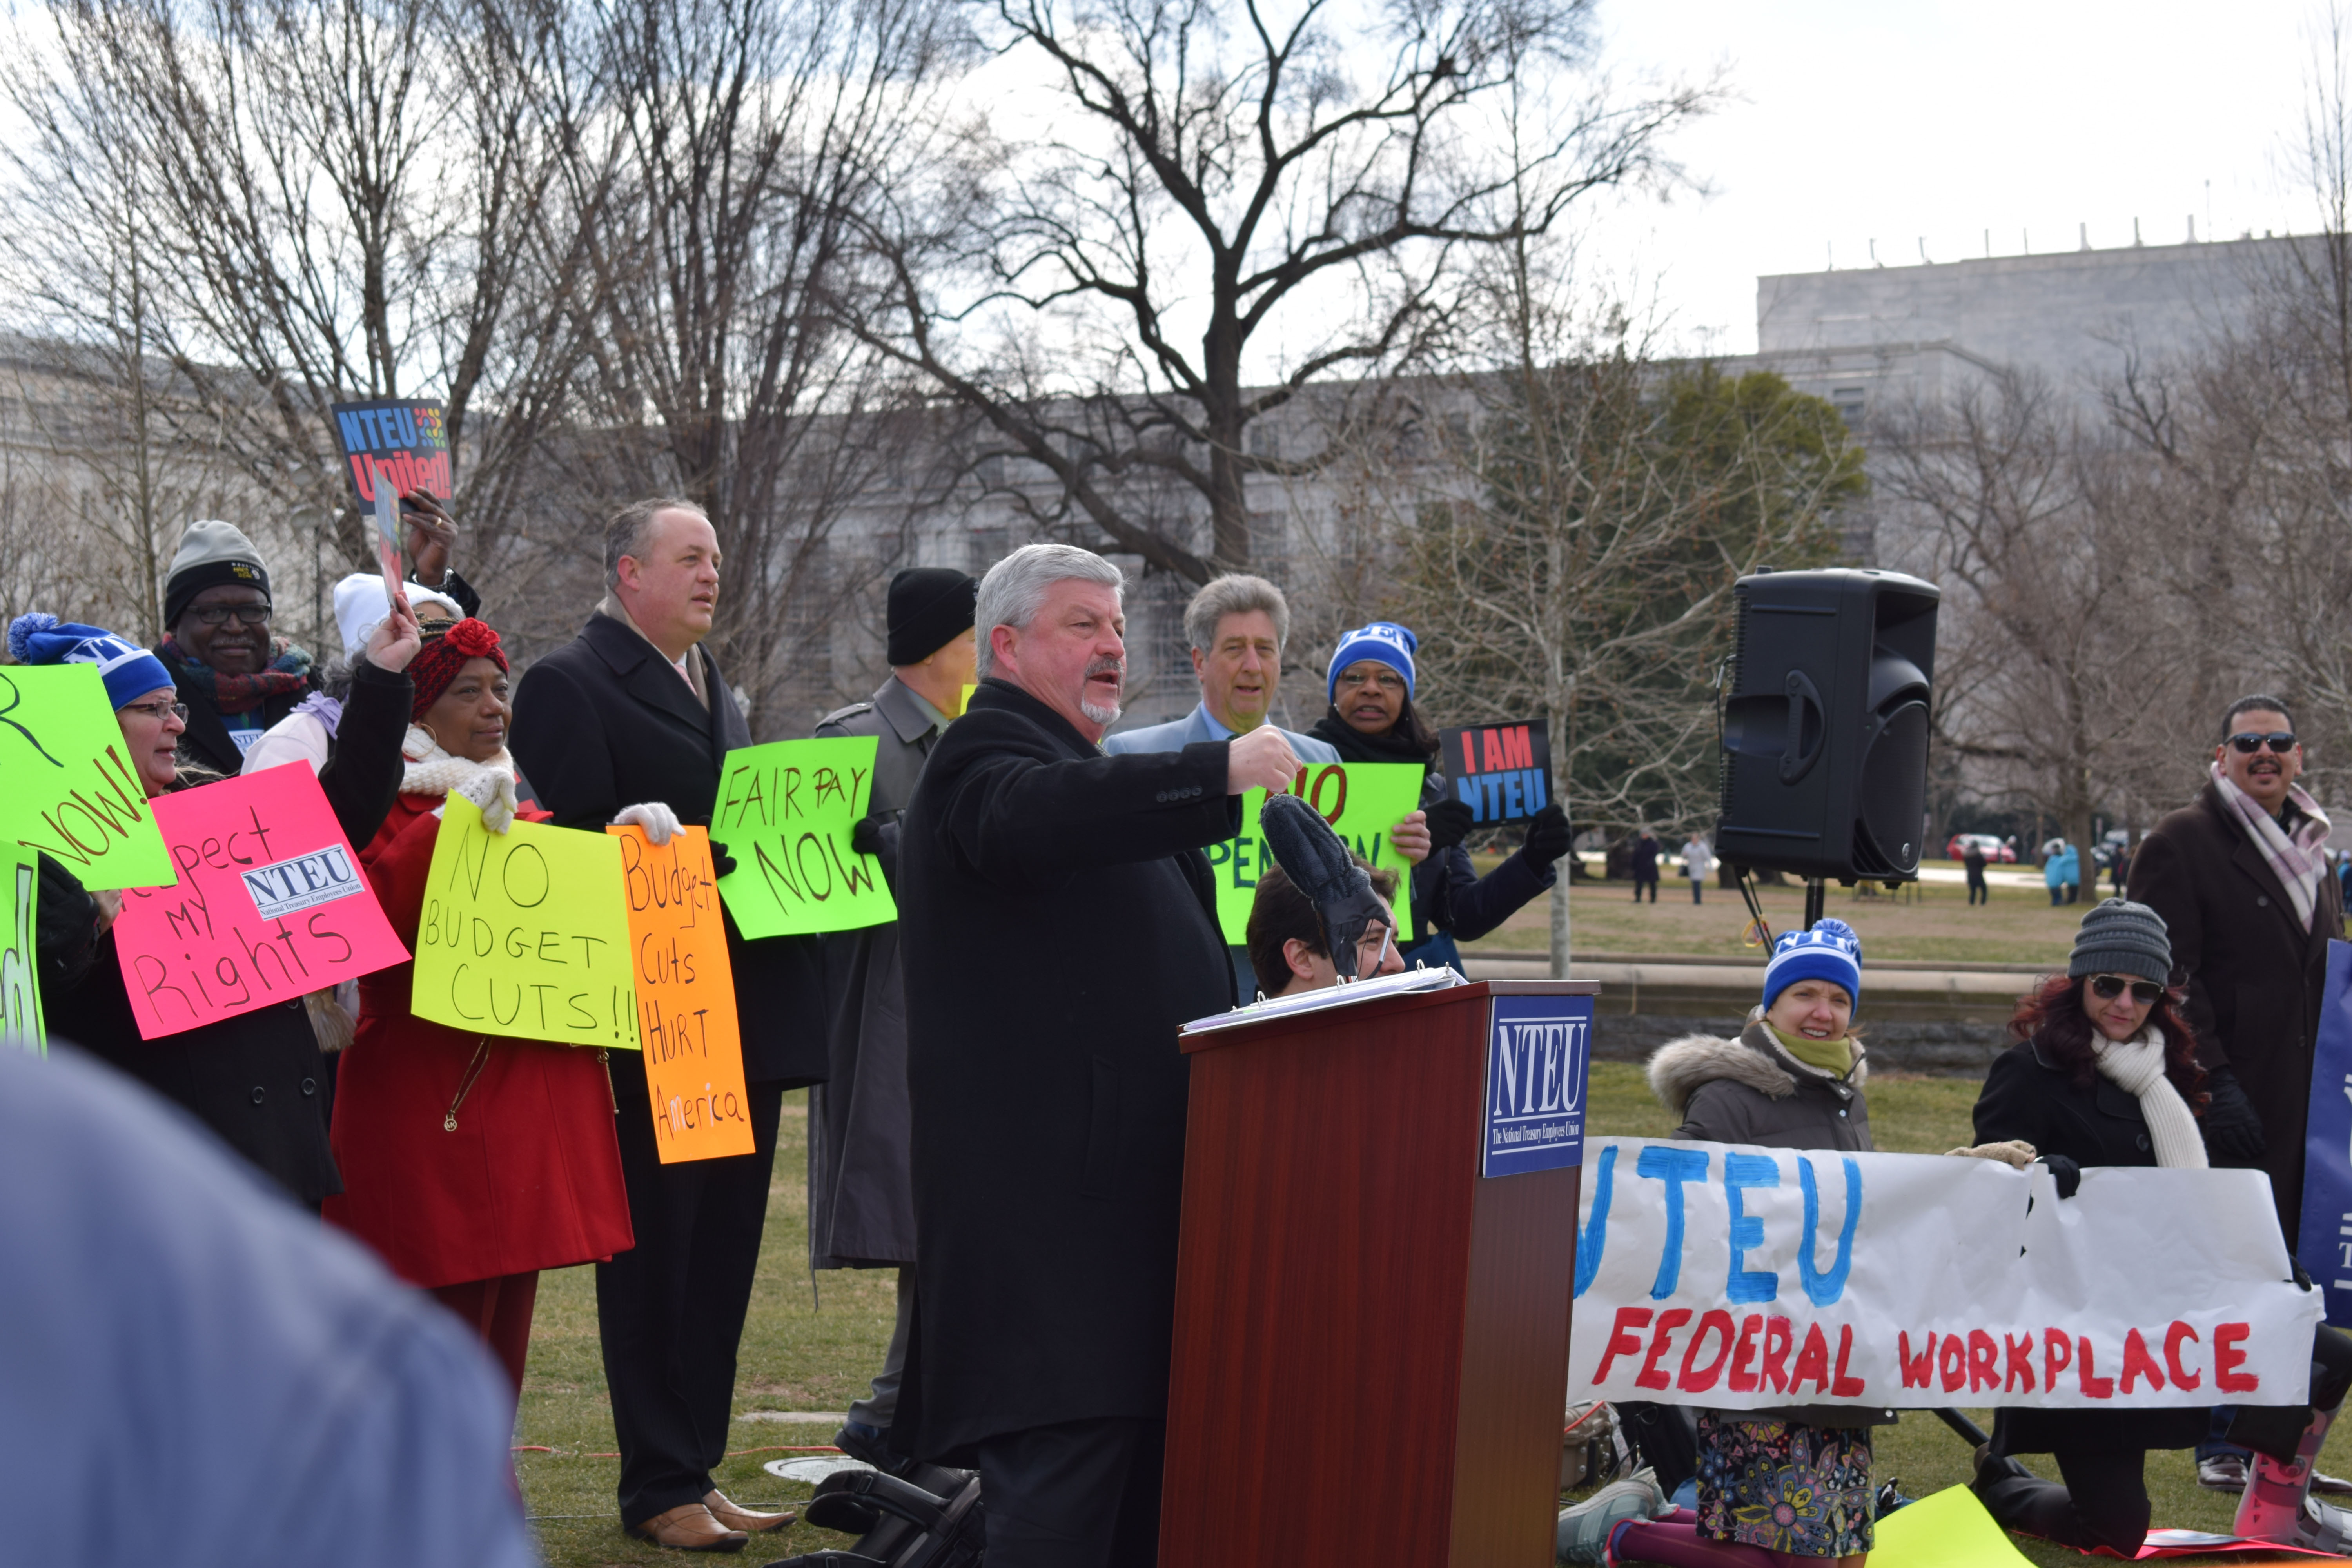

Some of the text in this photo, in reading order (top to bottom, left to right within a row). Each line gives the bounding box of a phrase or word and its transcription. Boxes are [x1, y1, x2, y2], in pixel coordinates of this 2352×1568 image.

[338, 407, 417, 452] NTEU
[350, 450, 452, 502] United!
[1461, 725, 1533, 774] I AM
[18, 744, 148, 866] NOW!
[720, 765, 867, 828] FAIR PAY
[1457, 768, 1547, 822] NTEU
[120, 805, 274, 912] pect
[243, 849, 351, 906] NTEU
[449, 823, 549, 908] NO
[620, 834, 712, 929] Budget
[753, 831, 875, 916] NOW
[165, 898, 215, 941] MY
[260, 883, 361, 916] National Treasury Employees Union
[425, 899, 608, 968] BUDGET
[640, 933, 695, 984] Cuts
[134, 912, 353, 1024] Rights
[451, 963, 635, 1043] CUTS!!
[1494, 1023, 1587, 1117] NTEU
[656, 1082, 745, 1142] America
[1493, 1120, 1579, 1145] The National Treasury Employees Union
[1591, 1307, 2260, 1399] FEDERAL WORKPLACE
